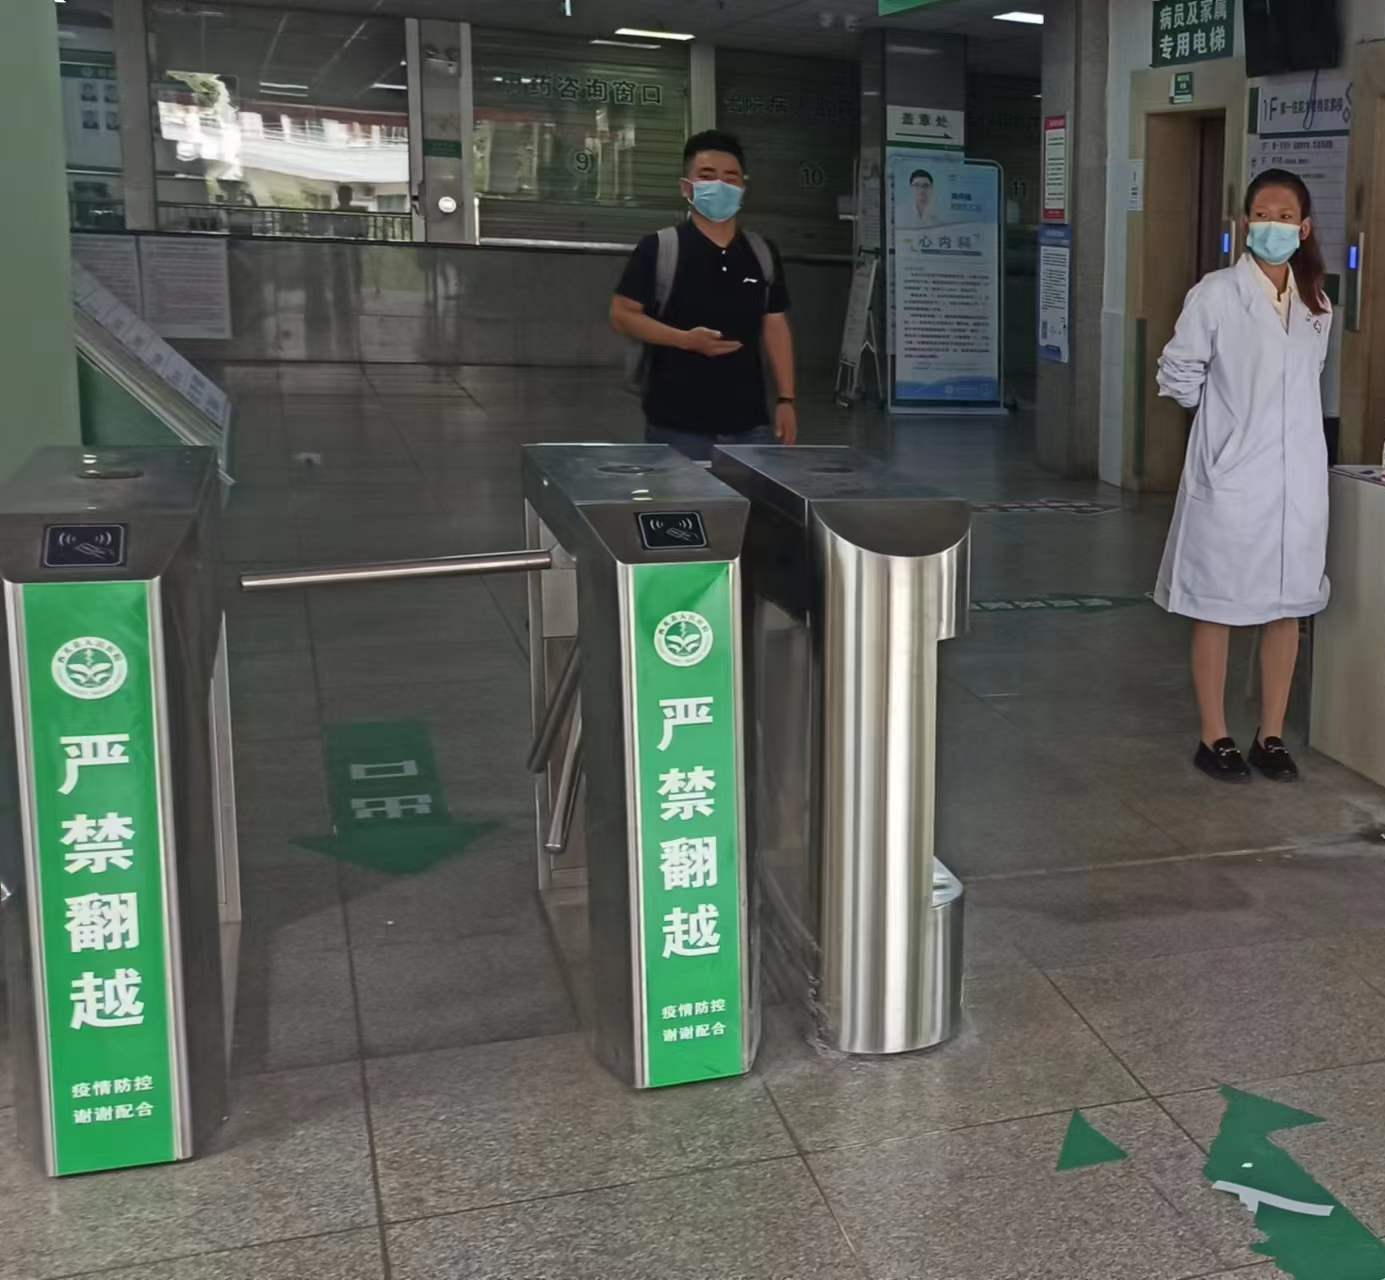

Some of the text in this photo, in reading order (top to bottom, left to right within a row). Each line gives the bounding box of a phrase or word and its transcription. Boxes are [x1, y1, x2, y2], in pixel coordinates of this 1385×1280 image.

[1160, 0, 1227, 30] 病员及家属
[1160, 26, 1226, 59] 专用电梯
[902, 112, 949, 128] 盖章处
[576, 152, 594, 173] 9
[802, 166, 825, 187] 10
[657, 696, 720, 960] 严禁翻越
[58, 733, 145, 1030] 严禁翻越
[661, 998, 726, 1020] 疫情防控
[663, 1021, 727, 1043] 谢谢配合
[72, 1075, 155, 1098] 疫情防控
[73, 1101, 155, 1124] 谢谢配合
